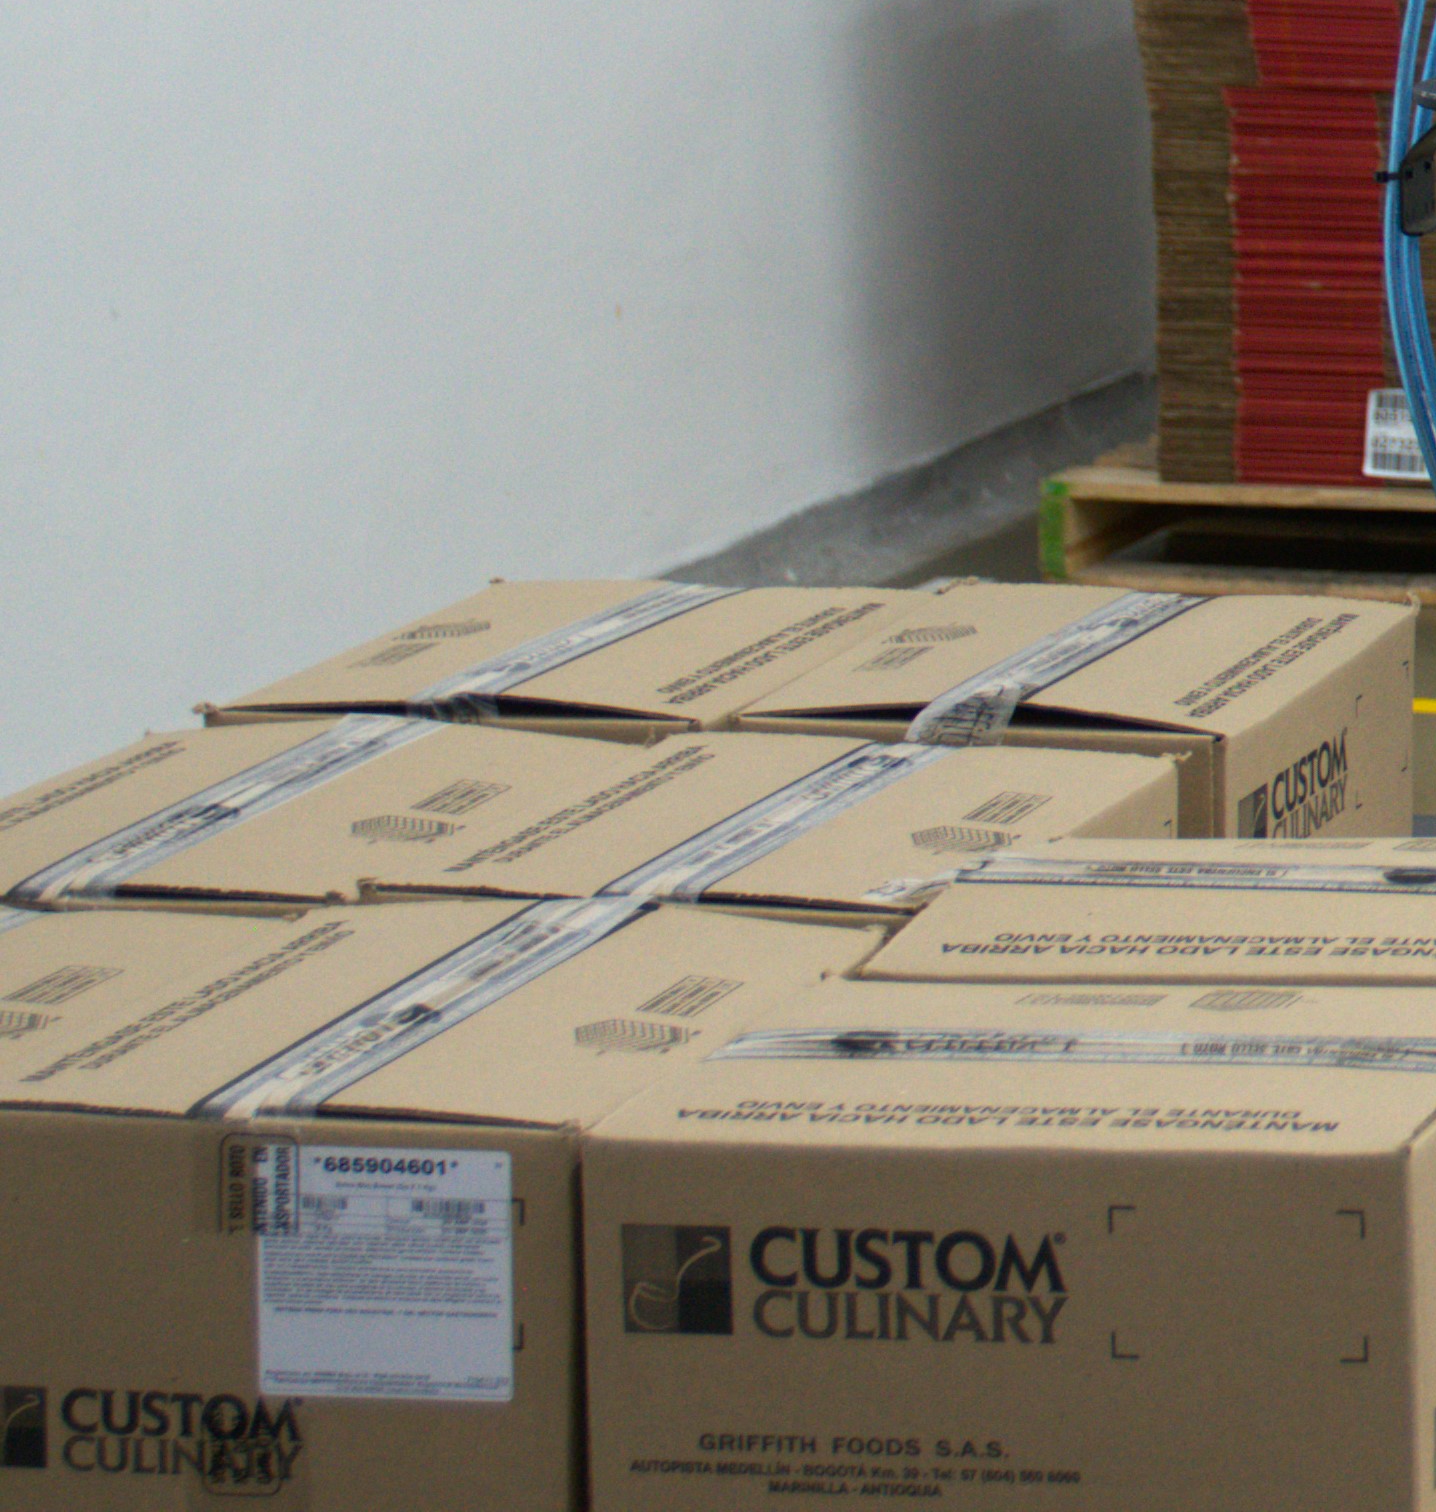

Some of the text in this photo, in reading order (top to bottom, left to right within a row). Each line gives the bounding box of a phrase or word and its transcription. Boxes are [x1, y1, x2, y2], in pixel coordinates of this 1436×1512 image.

[1271, 728, 1348, 820] CUSTOM
[1075, 933, 1093, 943] Y
[1100, 933, 1340, 945] ALMACENAMIENTO
[1343, 935, 1376, 945] EL
[941, 943, 1055, 955] ARRIBA
[1059, 944, 1151, 955] HACIA
[1156, 945, 1241, 956] LADO
[1246, 946, 1323, 957] ESTE
[736, 1099, 1302, 1119] DURANTE EL ALMACENAMIENTO Y ENVÍO
[676, 1109, 803, 1122] ARRIBA
[808, 1112, 909, 1124] HACIA
[916, 1114, 1009, 1126] LADO
[1014, 1116, 1103, 1127] ESTE
[749, 1227, 1067, 1294] CUSTOM
[753, 1292, 1069, 1344] CULINARY
[61, 1387, 299, 1442] CUSTOM
[699, 1432, 1010, 1459] GRIFFITH FOODS S.A.S.
